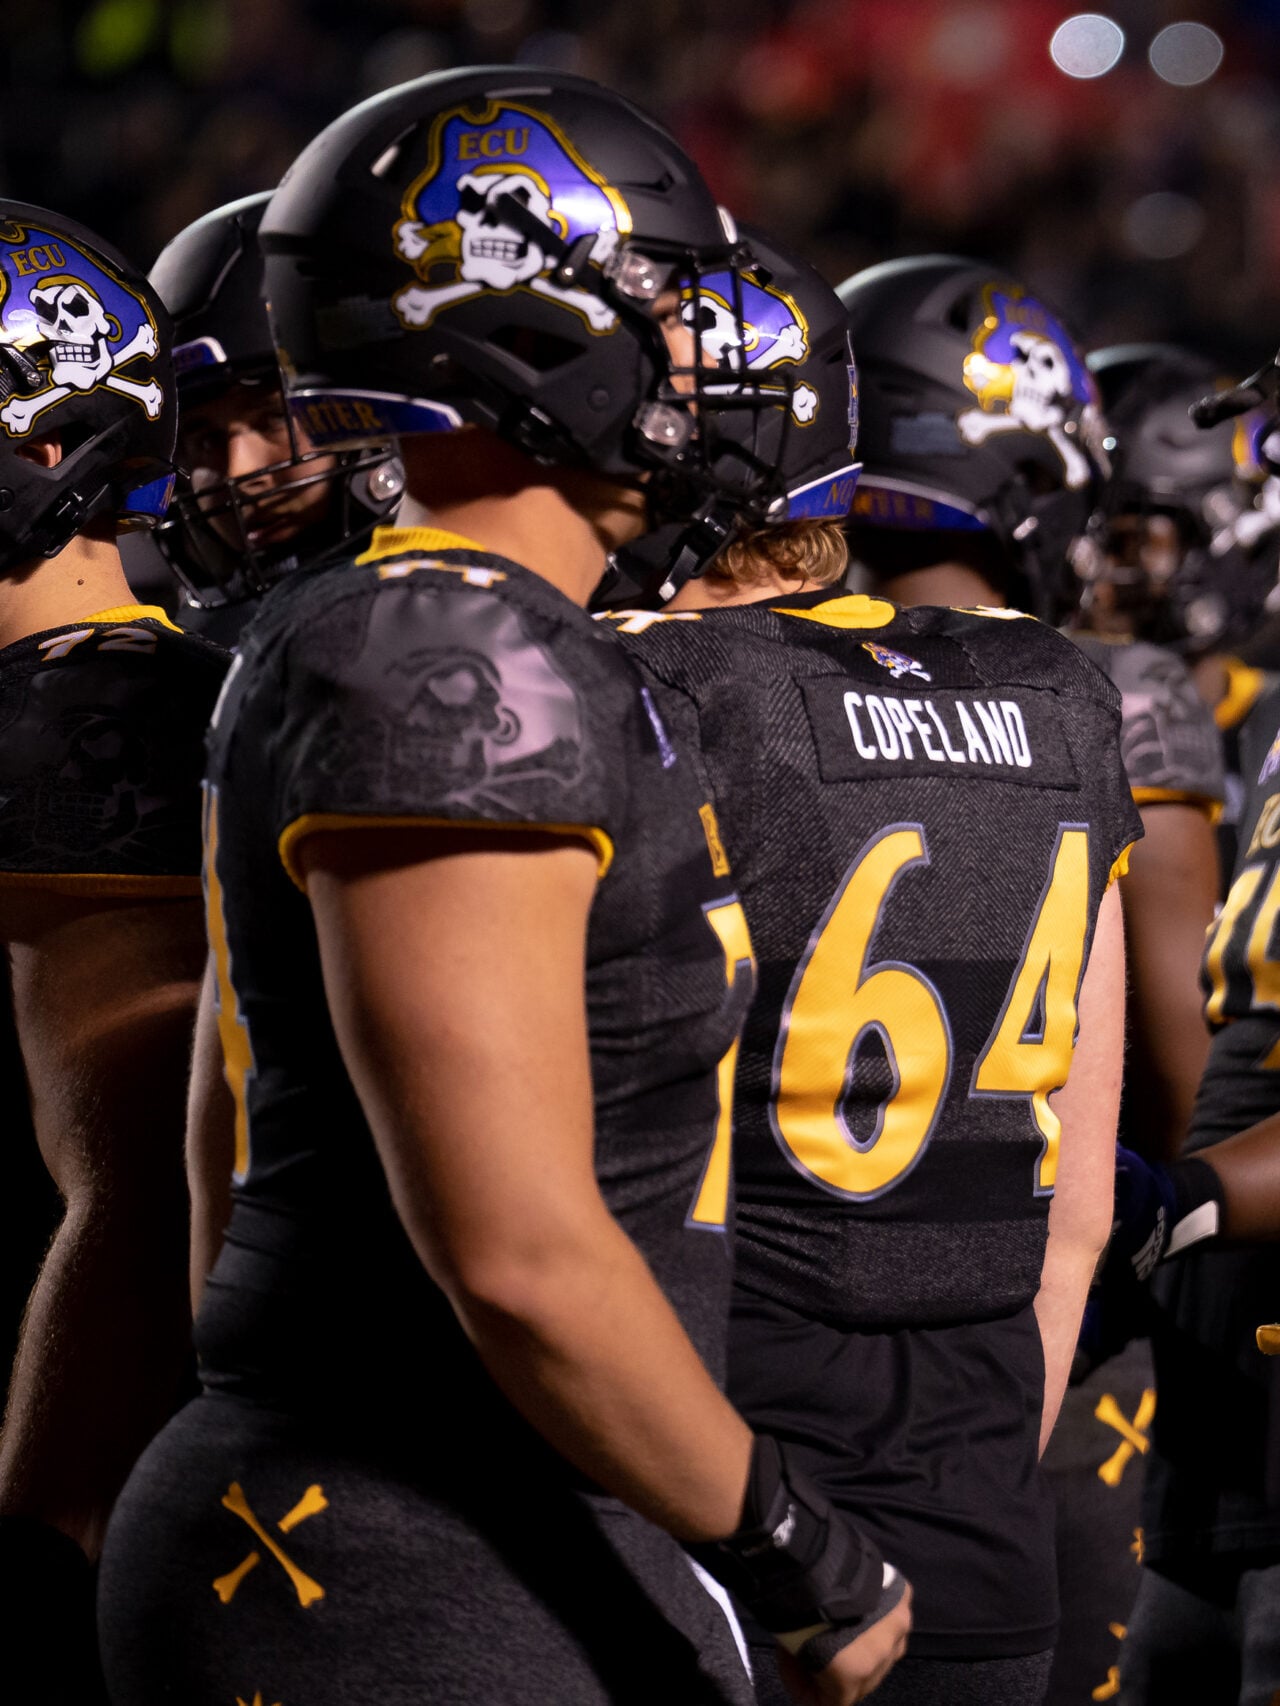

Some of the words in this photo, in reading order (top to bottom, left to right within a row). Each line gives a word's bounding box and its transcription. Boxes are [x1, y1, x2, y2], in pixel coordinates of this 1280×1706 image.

[457, 127, 530, 161] ECU
[9, 244, 67, 277] ECU
[37, 628, 159, 662] 72
[843, 691, 1033, 769] COPELAND
[768, 821, 1090, 1201] 64
